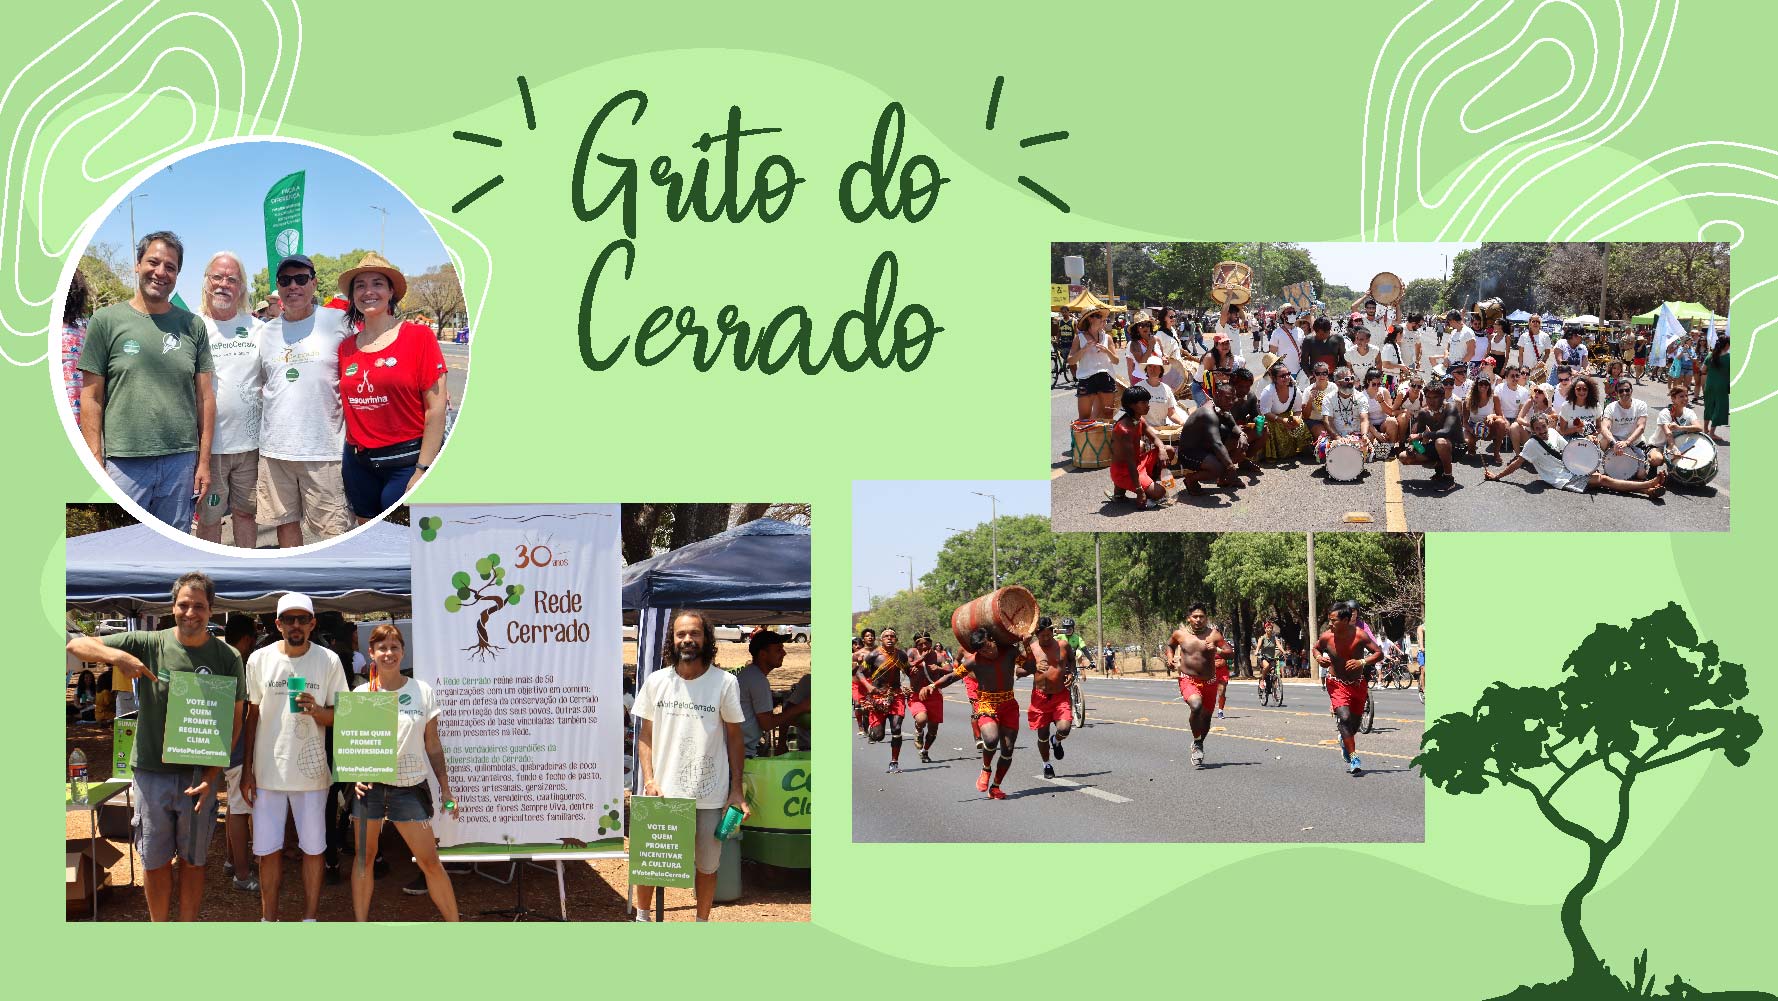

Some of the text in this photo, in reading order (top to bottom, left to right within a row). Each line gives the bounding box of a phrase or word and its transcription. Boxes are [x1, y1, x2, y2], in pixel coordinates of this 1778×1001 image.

[514, 544, 552, 568] 30
[534, 590, 582, 614] Rede
[506, 618, 590, 644] Cerrado
[444, 676, 460, 686] Rede
[462, 676, 492, 685] Cerrado
[516, 675, 533, 684] mais
[535, 675, 543, 683] de
[436, 687, 485, 697] organizações
[518, 686, 547, 695] objetivo
[472, 697, 497, 706] defesa
[510, 696, 556, 705] conservação
[570, 695, 598, 704] Cerrado
[555, 706, 581, 714] Outras
[184, 717, 217, 726] PROMETE
[517, 716, 554, 725] vinculadas
[178, 726, 212, 735] REGULAR
[463, 729, 500, 737] presentes
[464, 745, 508, 753] verdadeiros
[509, 744, 546, 754] guardiões
[521, 804, 547, 812] Sempre
[499, 814, 544, 824] agricultores
[632, 869, 690, 879] #VotePeloCerrado
